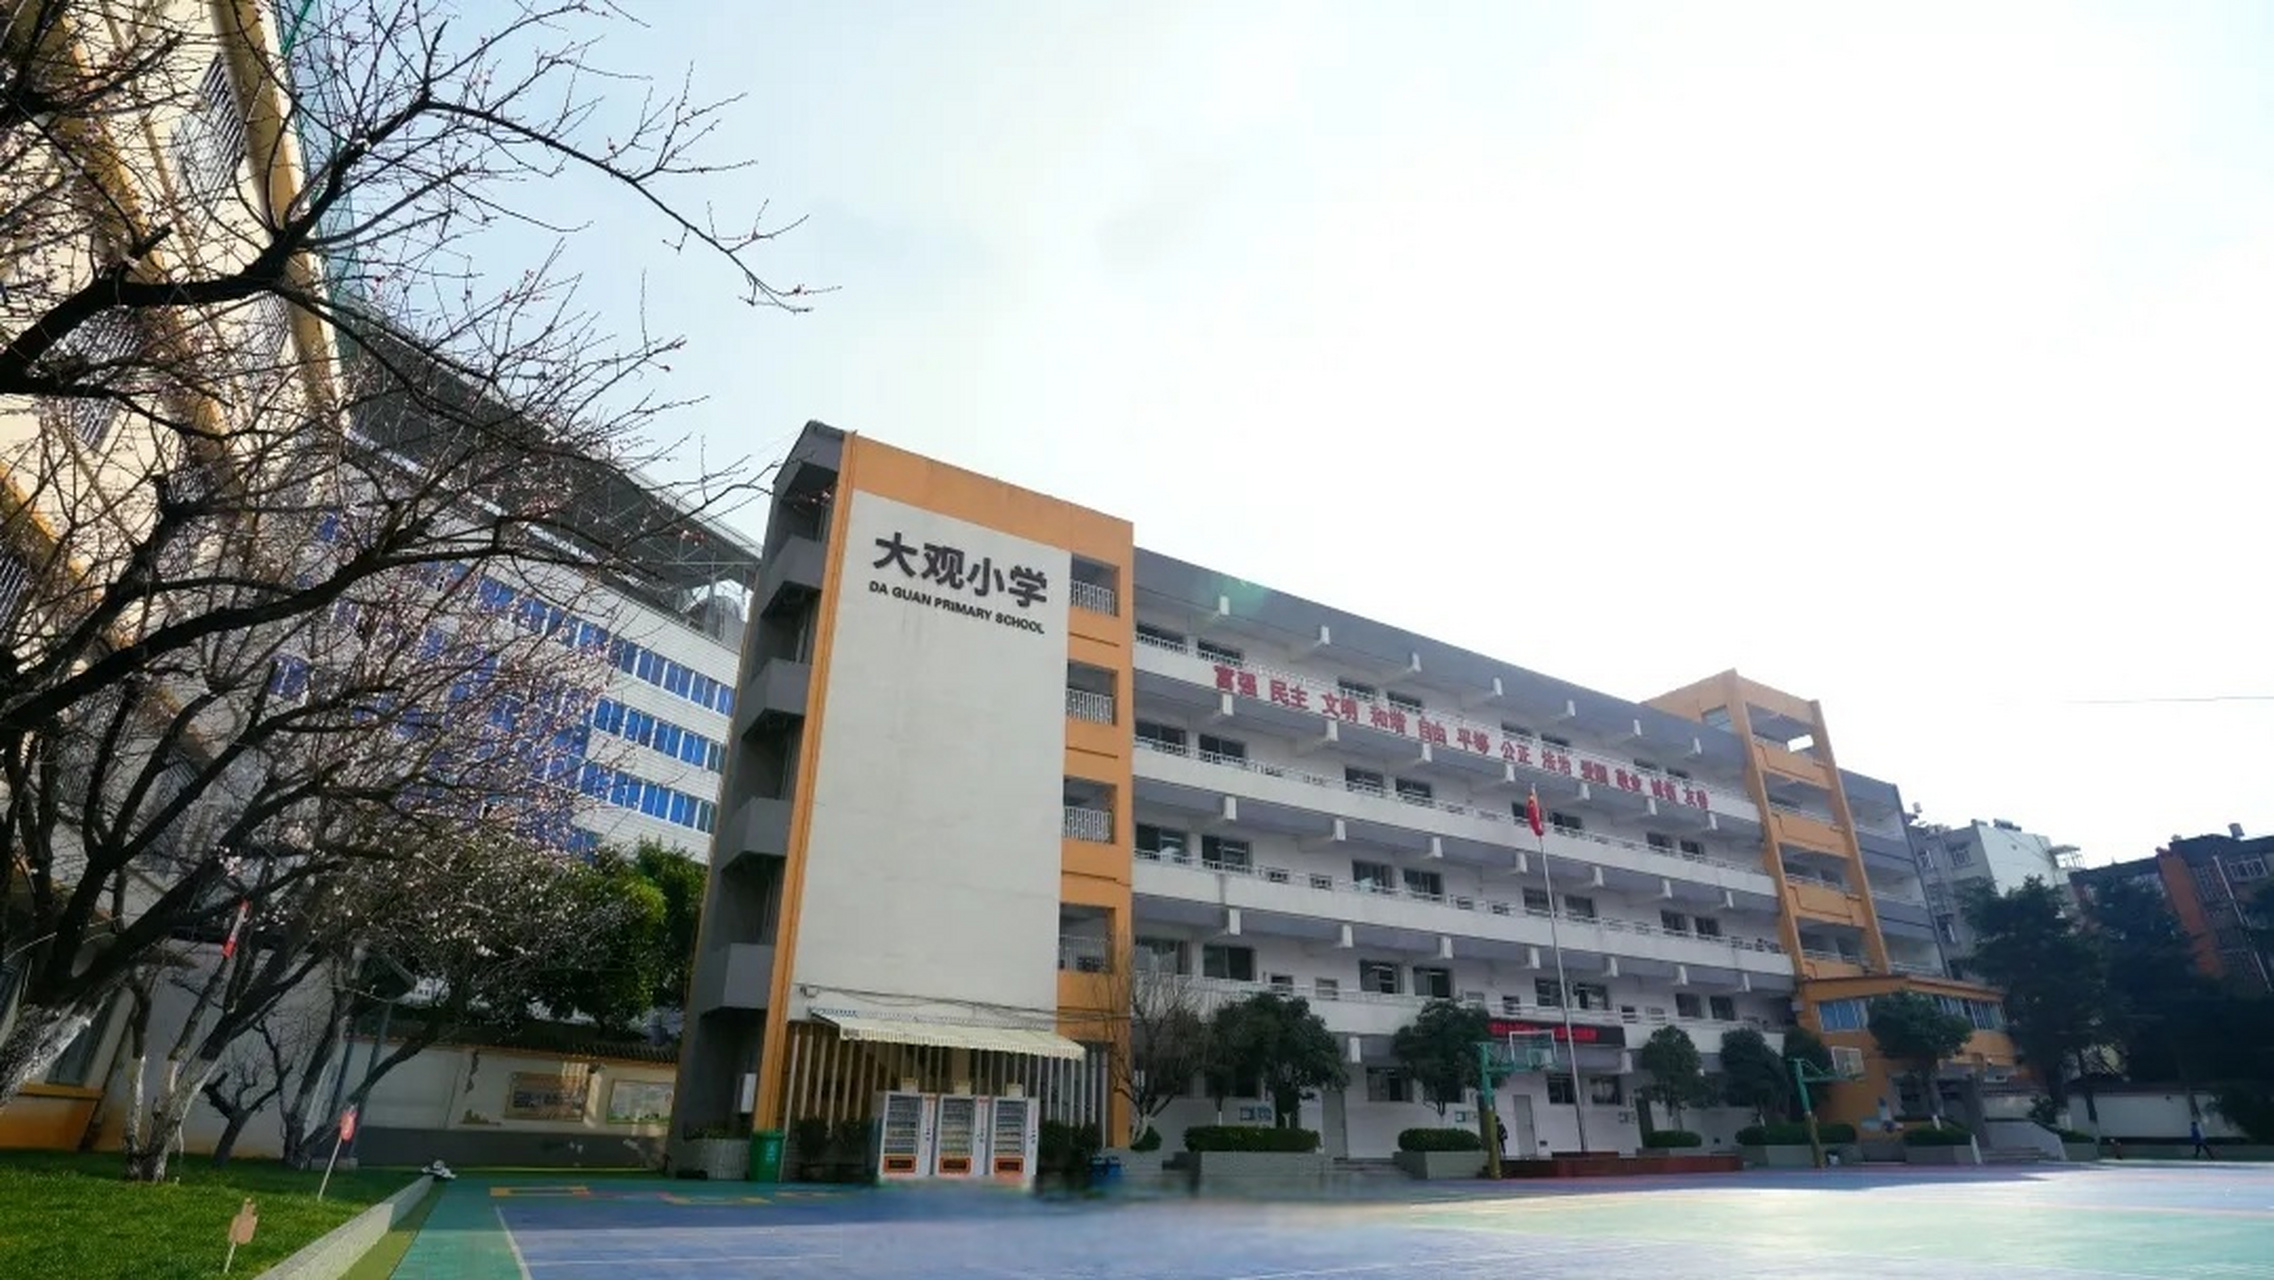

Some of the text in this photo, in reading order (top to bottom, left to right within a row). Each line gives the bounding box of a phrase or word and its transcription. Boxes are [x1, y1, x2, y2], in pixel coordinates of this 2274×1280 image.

[869, 580, 1045, 634] DA GUAN PRIMARY SCHOOL
[873, 532, 1047, 607] 大观小学
[1214, 664, 1257, 697] 富强
[1270, 680, 1309, 710] 民主
[1322, 692, 1358, 722] 文明
[1370, 706, 1407, 734] 和谐
[1418, 717, 1447, 746] 自由
[1457, 728, 1490, 755] 平等
[1501, 741, 1532, 764] 公正
[1541, 750, 1571, 775] 法治
